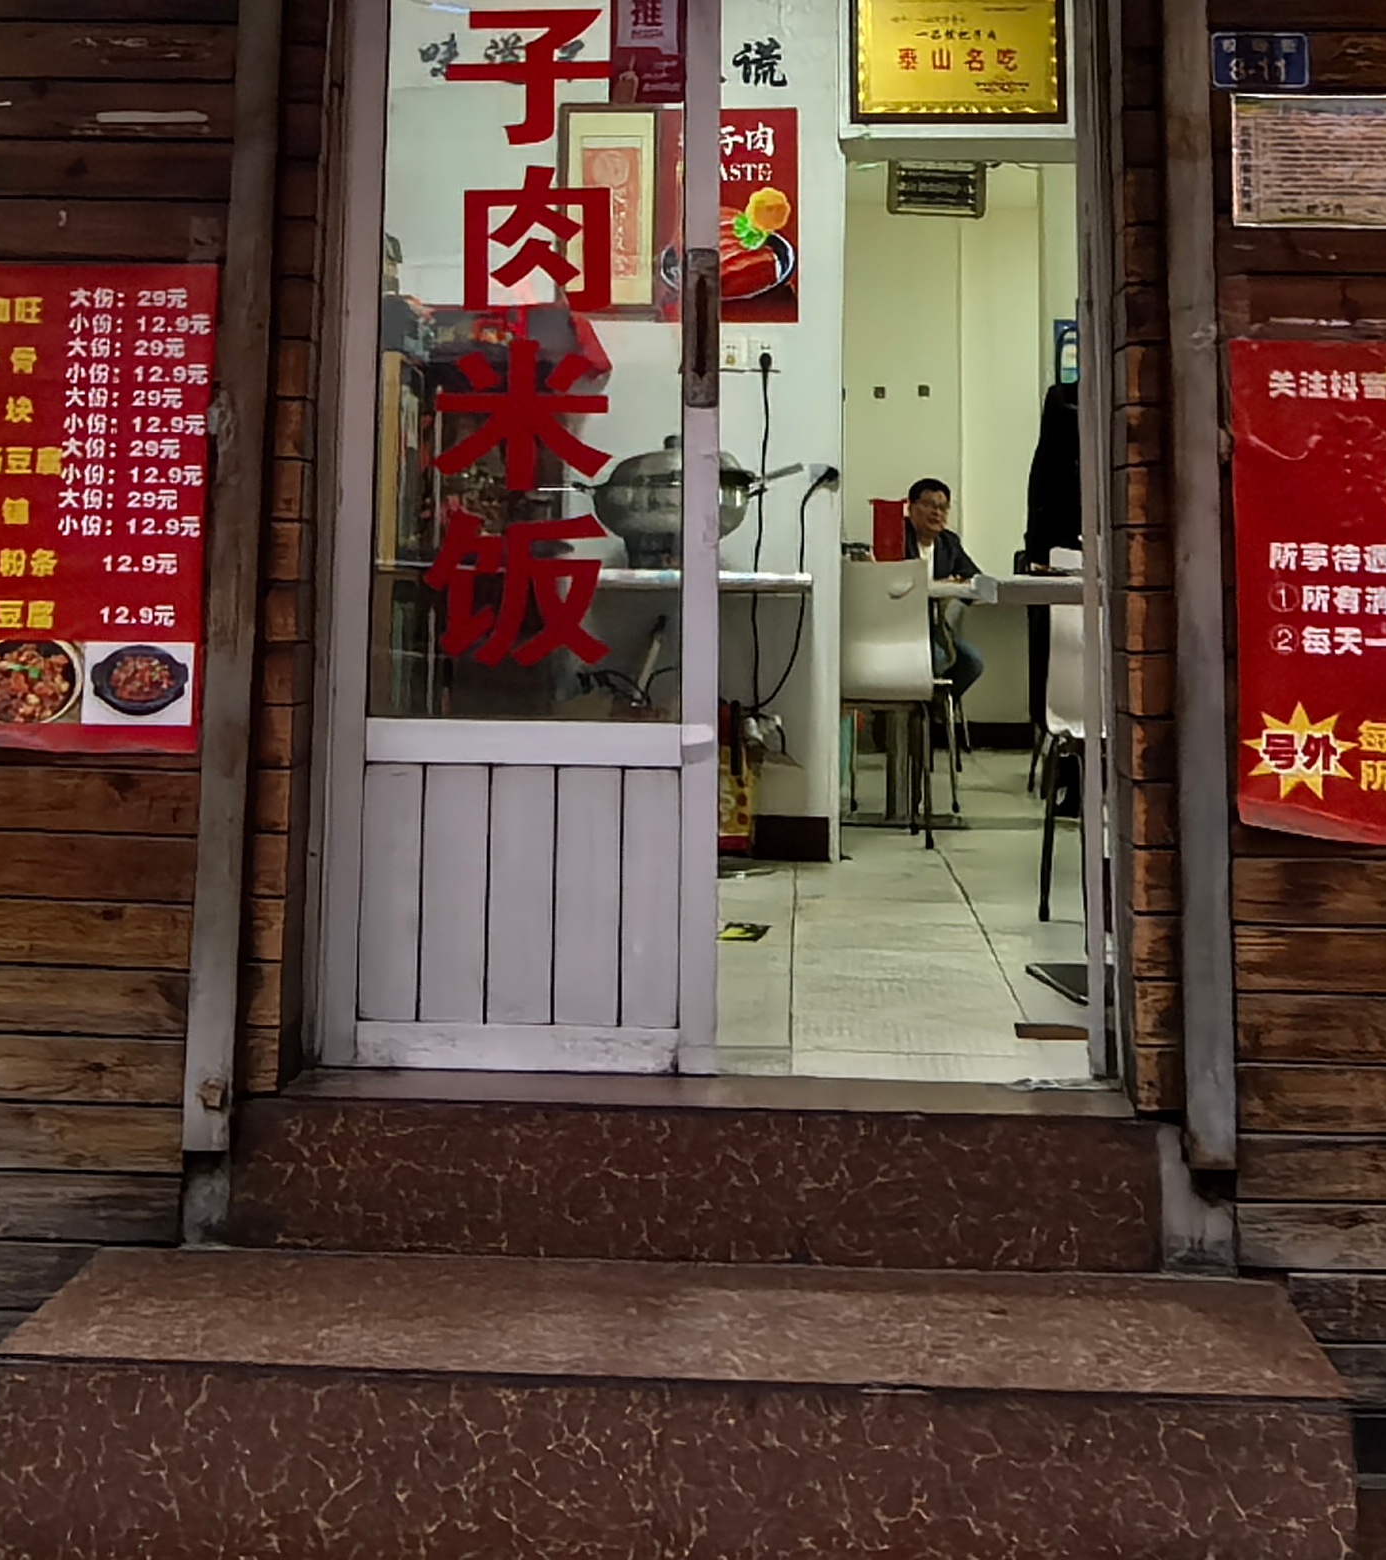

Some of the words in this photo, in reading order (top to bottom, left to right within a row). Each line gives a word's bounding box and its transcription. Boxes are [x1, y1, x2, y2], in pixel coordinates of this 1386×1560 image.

[102, 553, 179, 575] 12.9元
[99, 605, 176, 627] 12.9元
[1261, 729, 1341, 774] 号外
